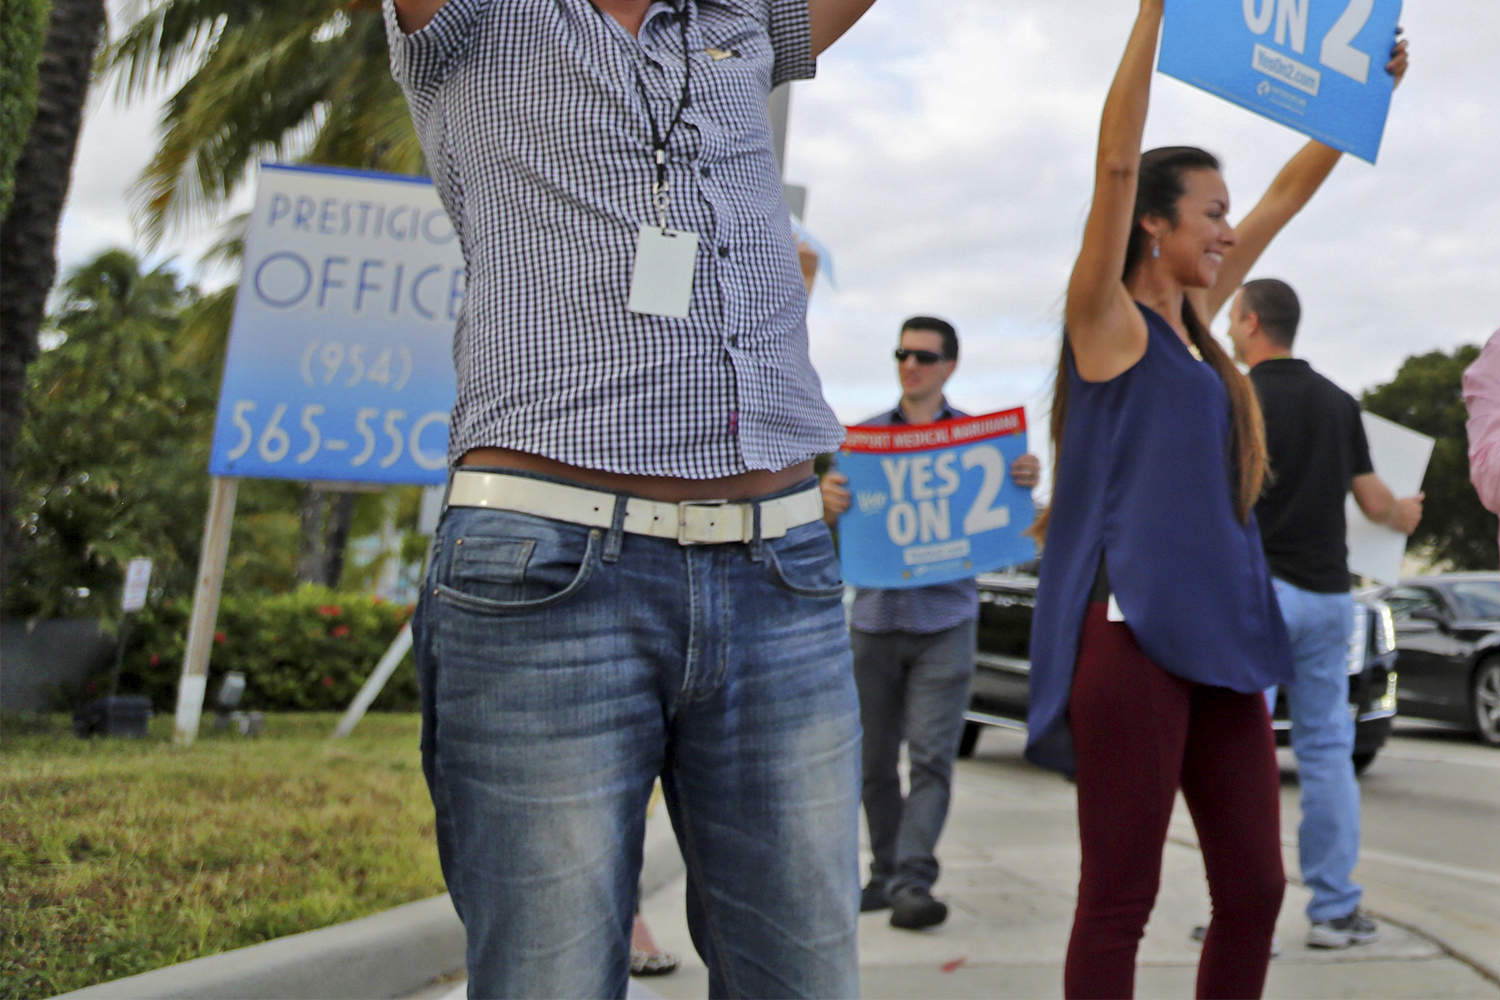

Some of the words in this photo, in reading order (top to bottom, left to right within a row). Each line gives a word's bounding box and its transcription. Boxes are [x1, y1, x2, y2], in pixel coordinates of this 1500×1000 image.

[300, 338, 414, 392] (954)
[879, 451, 962, 501] YES
[960, 443, 1011, 537] 2
[885, 498, 952, 547] ON
